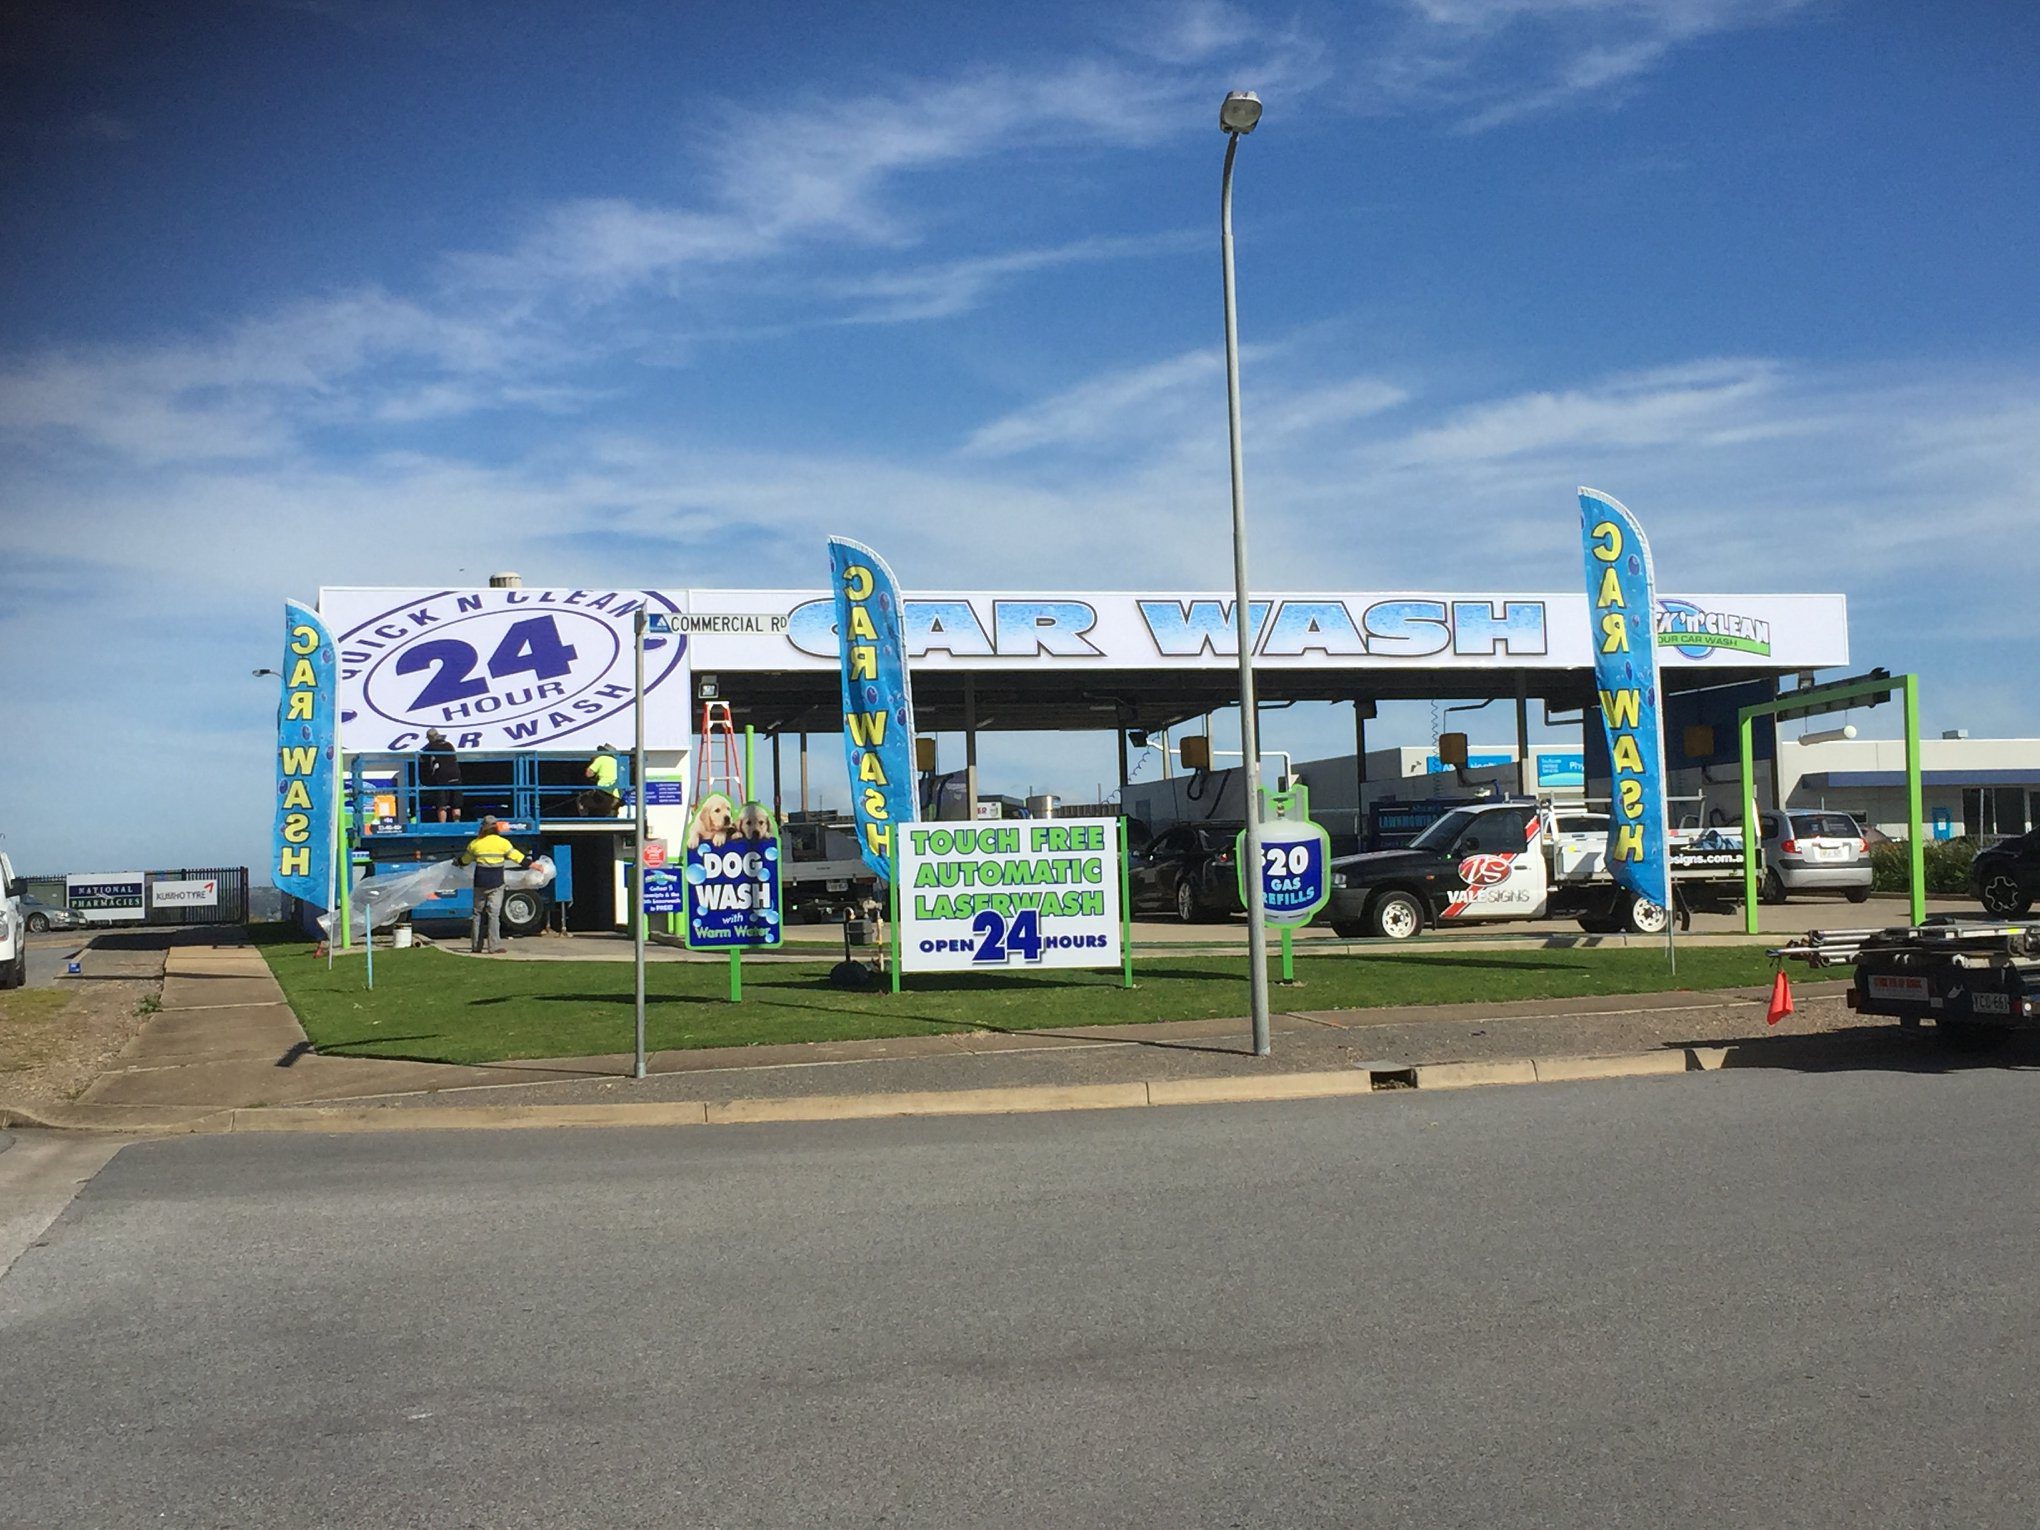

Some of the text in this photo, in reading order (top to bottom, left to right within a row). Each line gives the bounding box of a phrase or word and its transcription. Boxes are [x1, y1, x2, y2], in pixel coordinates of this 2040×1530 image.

[457, 594, 483, 614] N
[671, 616, 763, 632] COMMERCIAL
[1136, 599, 1548, 657] WASH
[1658, 635, 1738, 647] OUR CAR WASH
[396, 614, 578, 713] 24
[442, 681, 566, 722] HOUR
[387, 683, 632, 750] CR WASH
[910, 825, 1105, 855] TOUCH FREE
[703, 851, 763, 879] DOG
[1669, 853, 1744, 866] signs.com.a
[914, 857, 1102, 888] AUTOMATIC
[1271, 876, 1302, 891] GAS
[78, 885, 133, 895] NATIONAL
[186, 890, 206, 900] TYRE
[696, 883, 771, 911] WASH
[71, 898, 141, 908] PHARMACIES
[915, 890, 1105, 920] LASERWASH
[722, 912, 743, 924] with
[695, 925, 771, 939] Warm Water
[919, 909, 1107, 962] OPEN 24 HOURS
